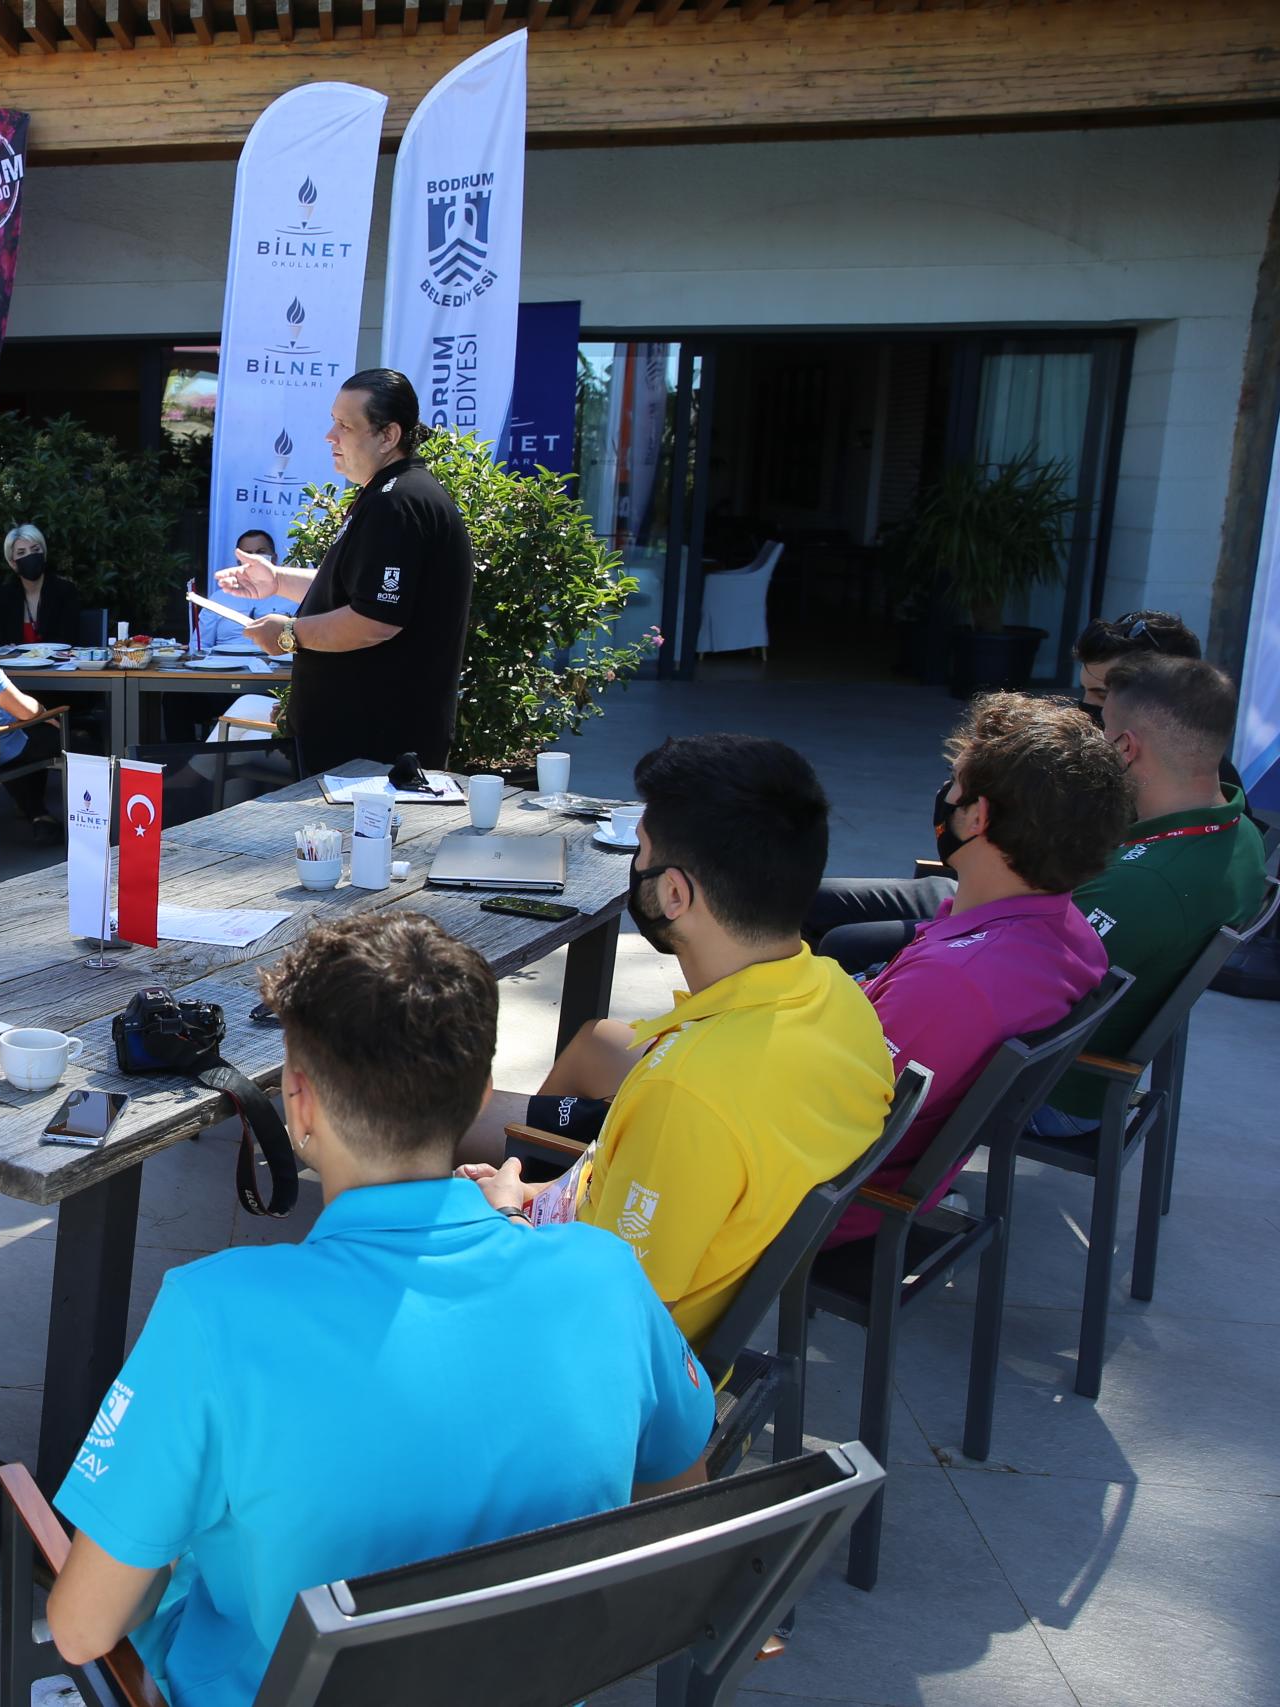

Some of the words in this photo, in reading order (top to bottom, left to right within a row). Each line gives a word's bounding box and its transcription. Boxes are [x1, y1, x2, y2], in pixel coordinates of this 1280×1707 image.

[427, 172, 494, 194] BODRUM
[257, 236, 352, 258] BİLNET
[271, 260, 334, 269] OKULLARI
[420, 269, 498, 308] BELEDİYESİ
[246, 355, 340, 377] BİLNET
[260, 378, 324, 388] OKULLARI
[70, 813, 108, 826] BİLNET
